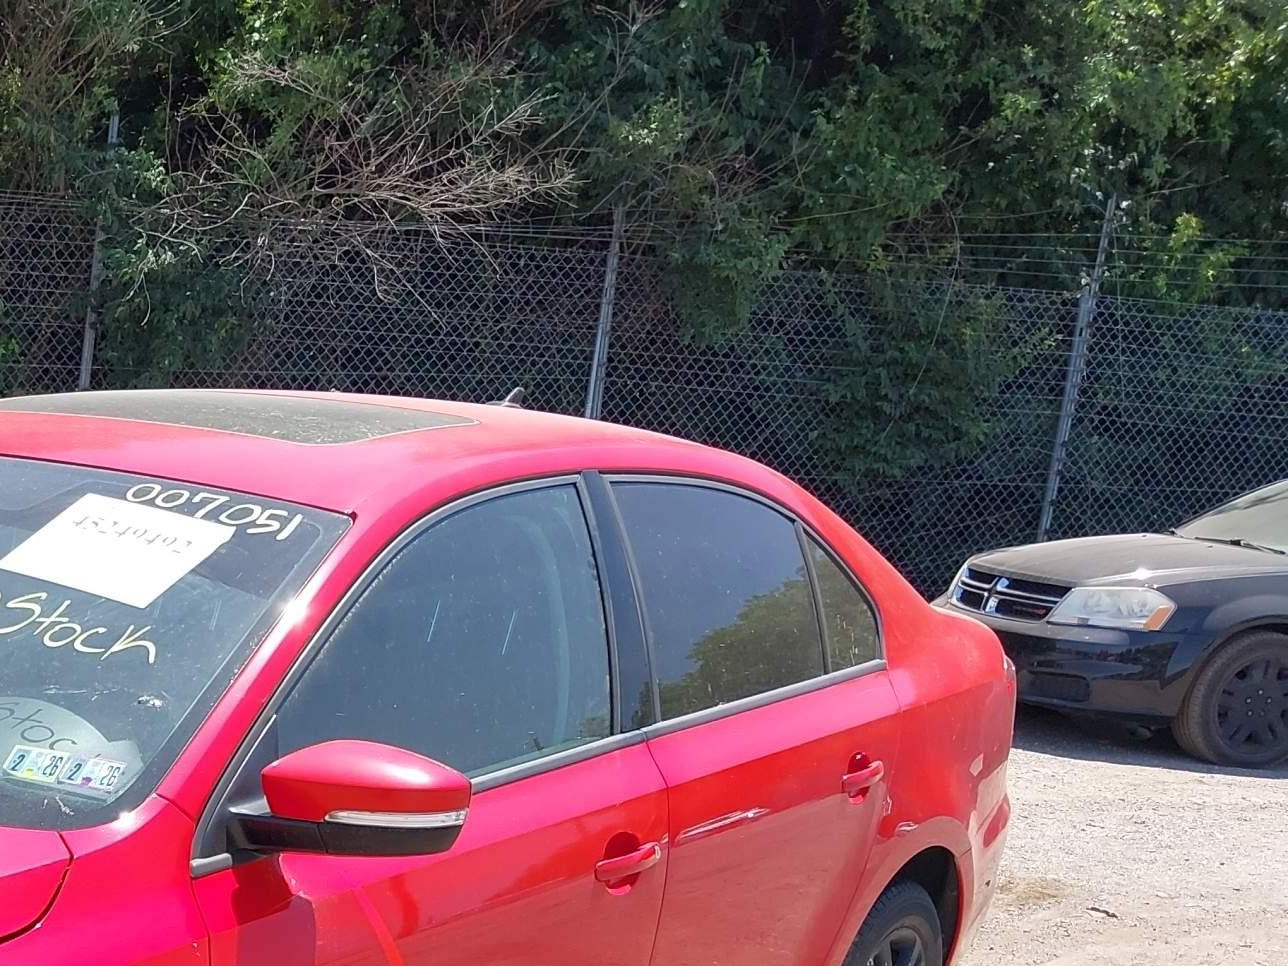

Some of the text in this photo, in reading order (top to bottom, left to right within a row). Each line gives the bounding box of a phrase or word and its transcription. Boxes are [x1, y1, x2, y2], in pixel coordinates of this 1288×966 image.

[125, 483, 304, 541] 007051
[10, 753, 64, 777] 2 26
[67, 762, 121, 787] 2 26
